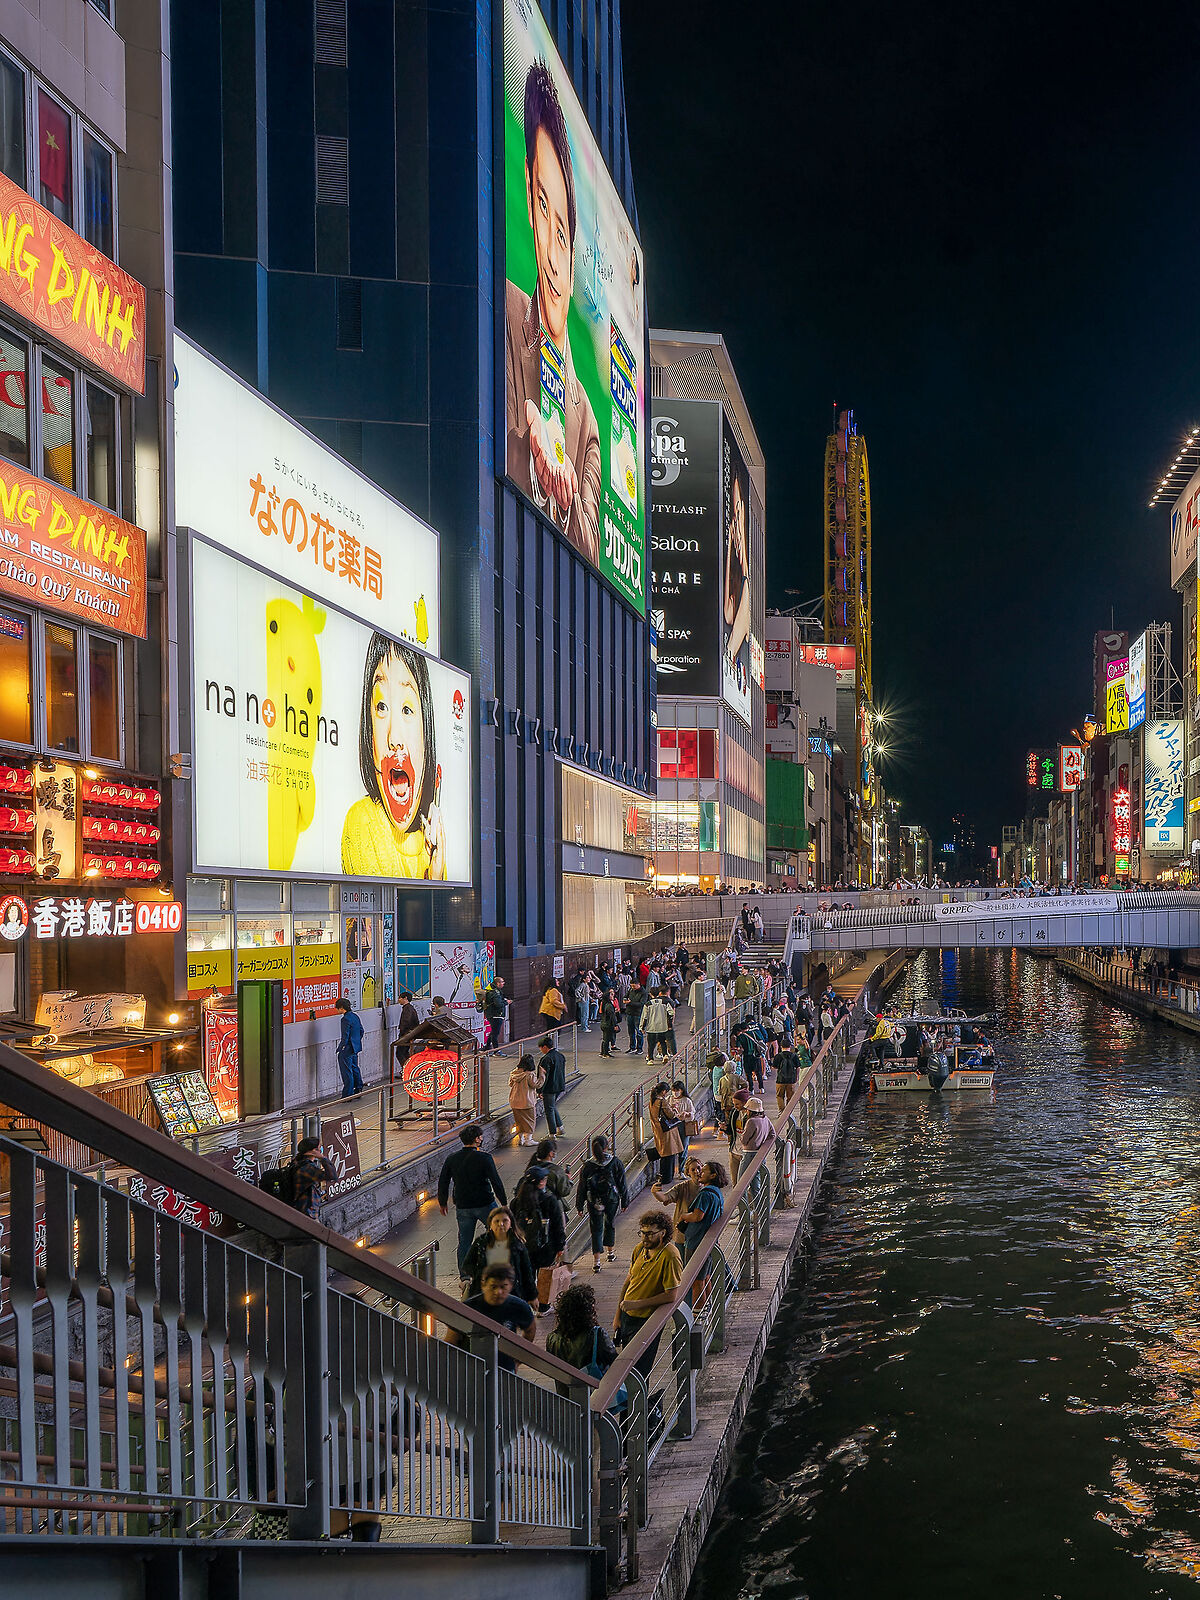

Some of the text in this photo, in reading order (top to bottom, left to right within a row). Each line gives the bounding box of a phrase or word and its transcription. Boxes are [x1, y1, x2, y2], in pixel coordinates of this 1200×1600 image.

[48, 241, 136, 356] DINH
[273, 455, 366, 531] ちかくにいる。ちからになる。
[48, 498, 132, 569] DINH
[249, 471, 383, 601] なの花薬局
[30, 539, 132, 594] RESTAURANT
[41, 574, 72, 601] Quý
[74, 588, 121, 618] Khách!
[246, 734, 277, 751] Healthcare
[246, 758, 282, 786] 油菜花
[286, 777, 309, 791] SHOP
[32, 897, 182, 939] 香港飯店 0410
[978, 930, 1047, 940] えびす橋
[237, 957, 289, 974] オーガニックコスメ
[299, 954, 335, 968] ブランドコスメ
